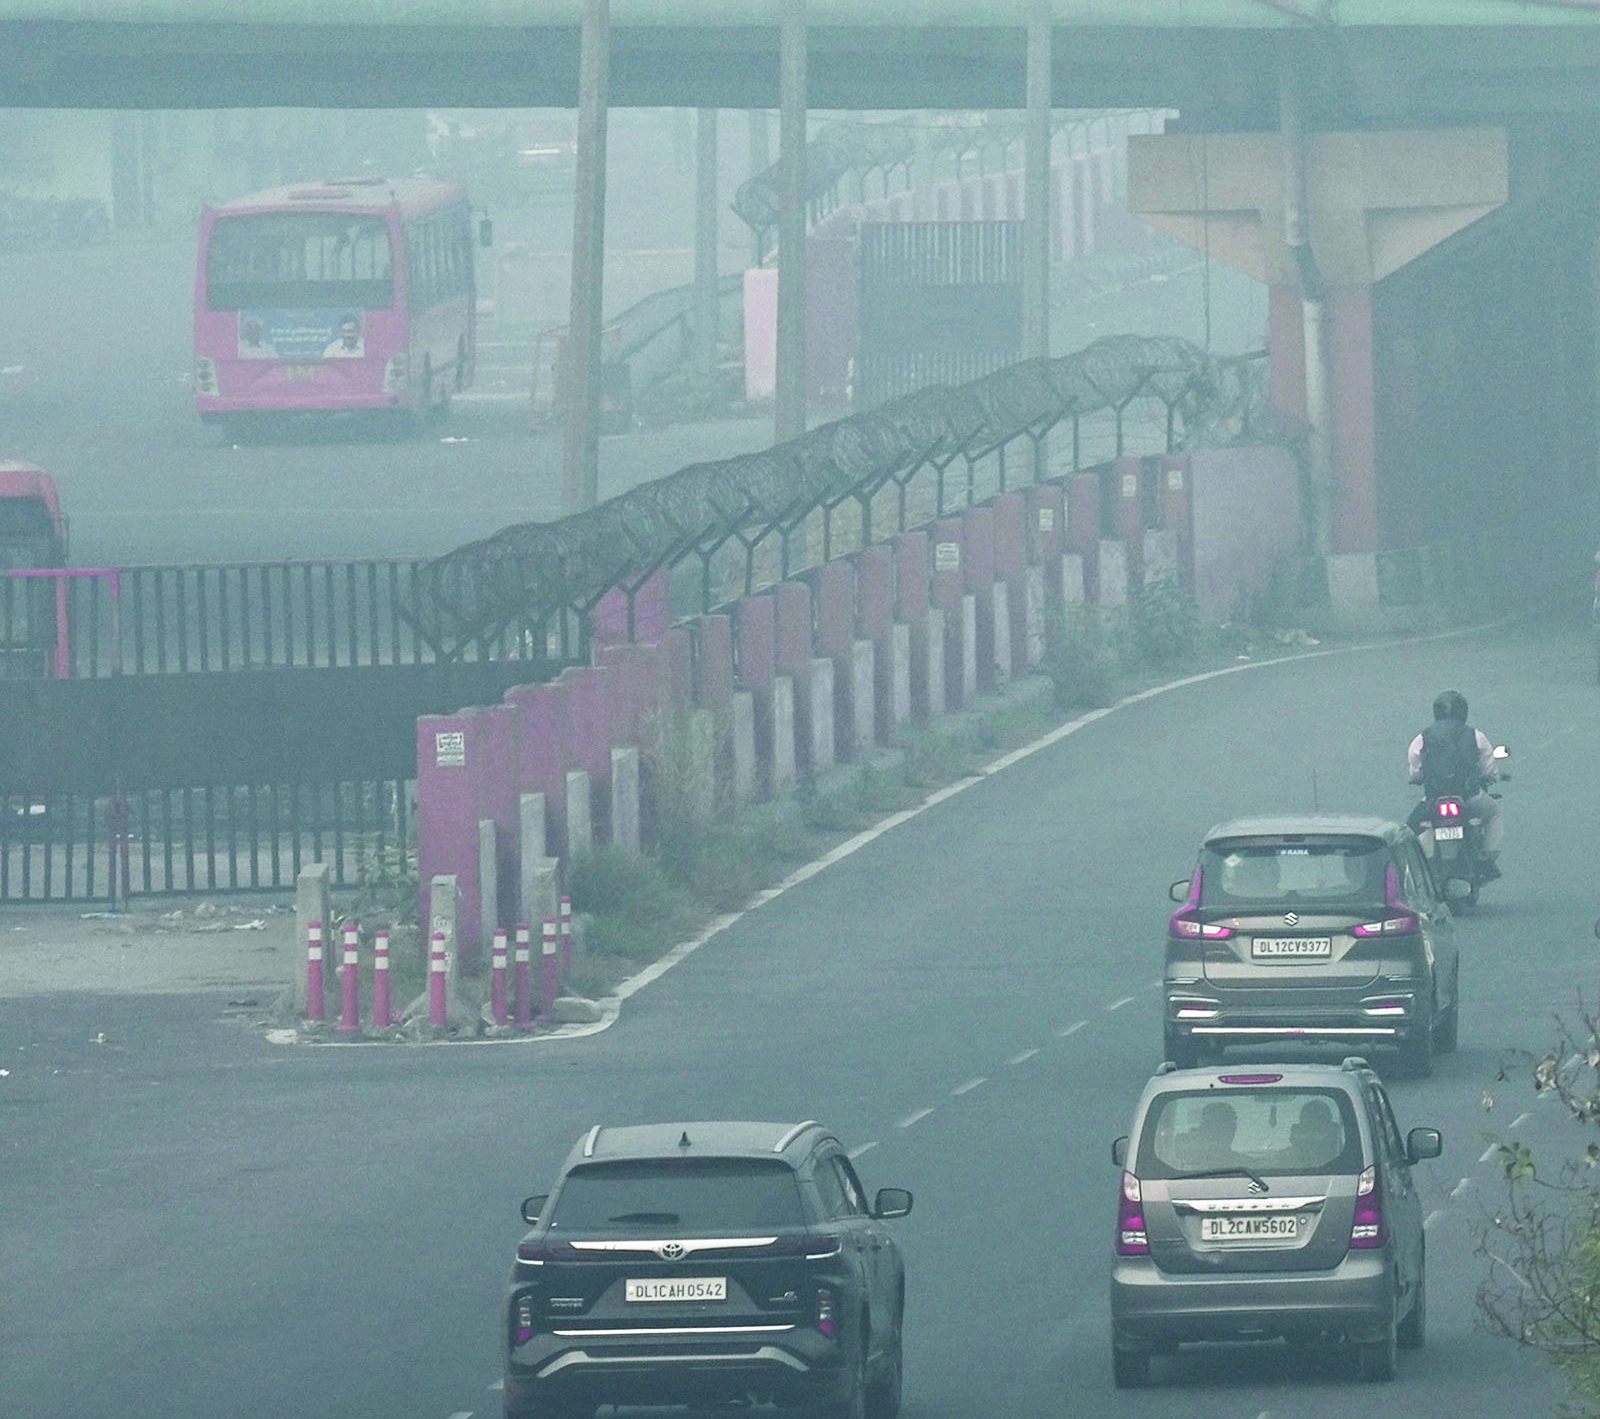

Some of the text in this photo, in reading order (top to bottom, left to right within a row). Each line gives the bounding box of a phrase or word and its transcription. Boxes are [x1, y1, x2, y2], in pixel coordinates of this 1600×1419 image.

[1260, 940, 1328, 953] DL12CV9377
[1211, 1219, 1295, 1235] DL2CAW5602
[636, 1283, 722, 1298] DL1CAH0542
